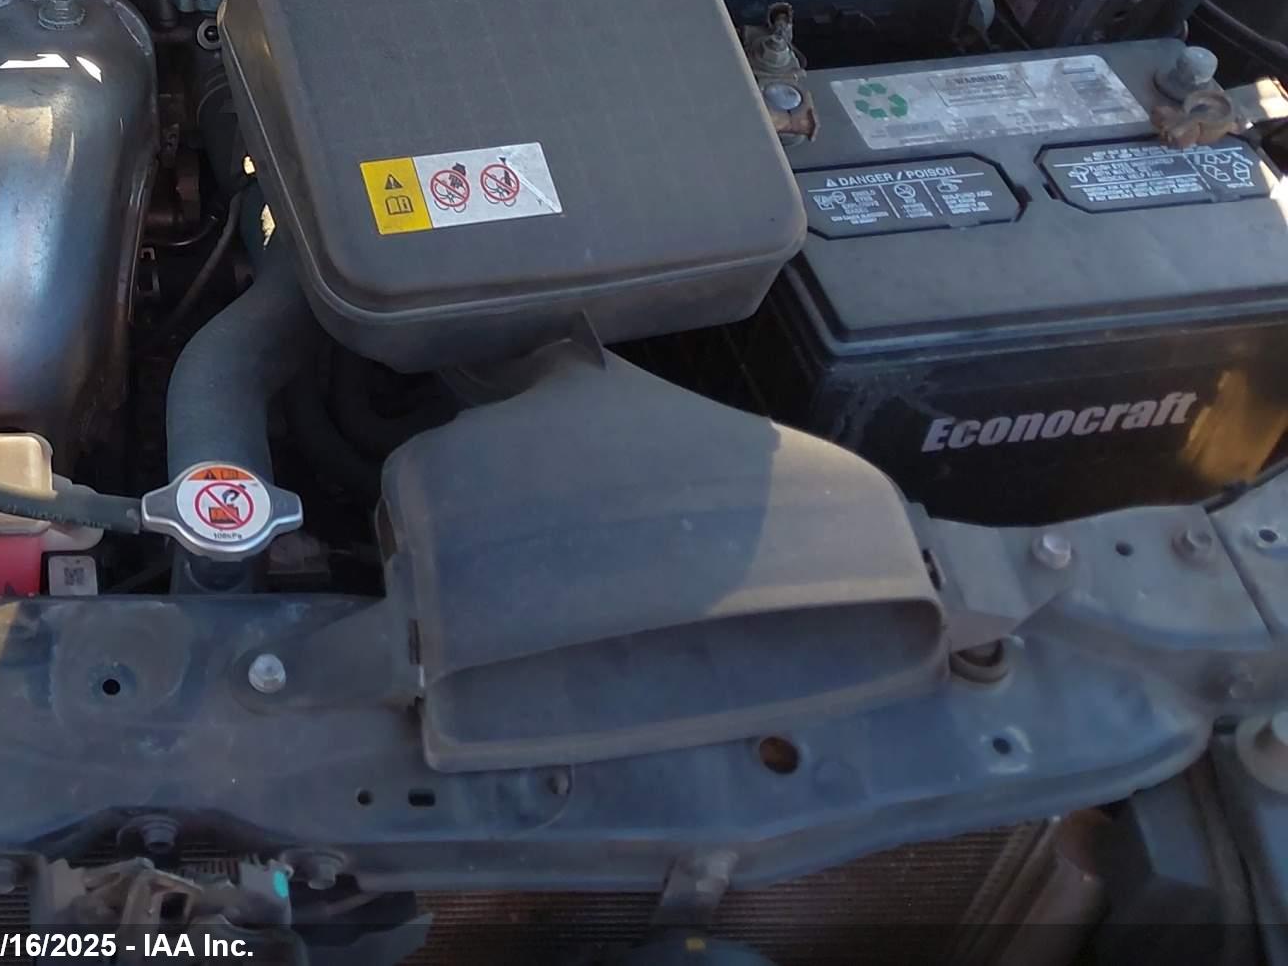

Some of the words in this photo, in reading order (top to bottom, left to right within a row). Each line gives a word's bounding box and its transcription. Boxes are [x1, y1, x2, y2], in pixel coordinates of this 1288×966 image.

[838, 173, 893, 187] DANGER
[906, 166, 956, 179] POISON
[921, 392, 1197, 452] Econocraft
